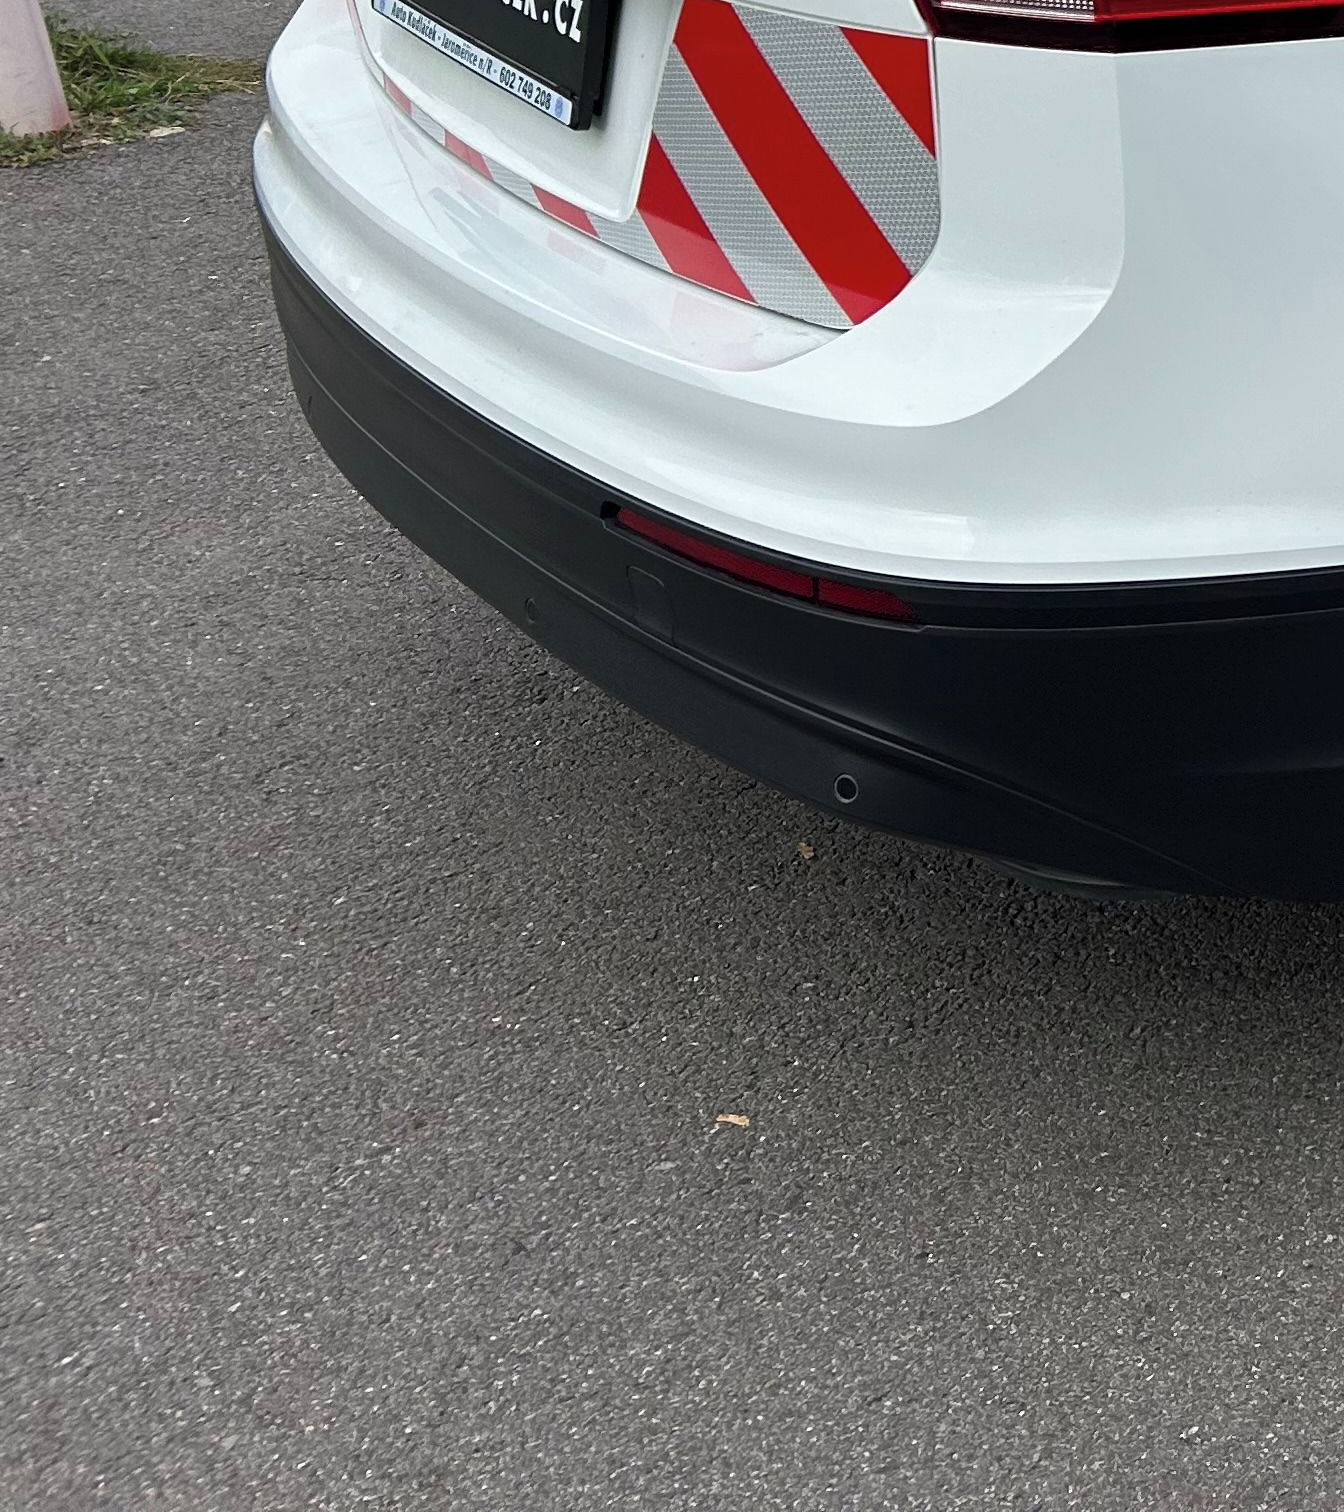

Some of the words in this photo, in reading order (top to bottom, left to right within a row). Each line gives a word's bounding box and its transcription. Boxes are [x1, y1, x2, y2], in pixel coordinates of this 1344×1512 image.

[391, 1, 407, 23] Auto
[500, 66, 516, 89] 602
[517, 76, 533, 99] 749
[534, 87, 552, 110] 208
